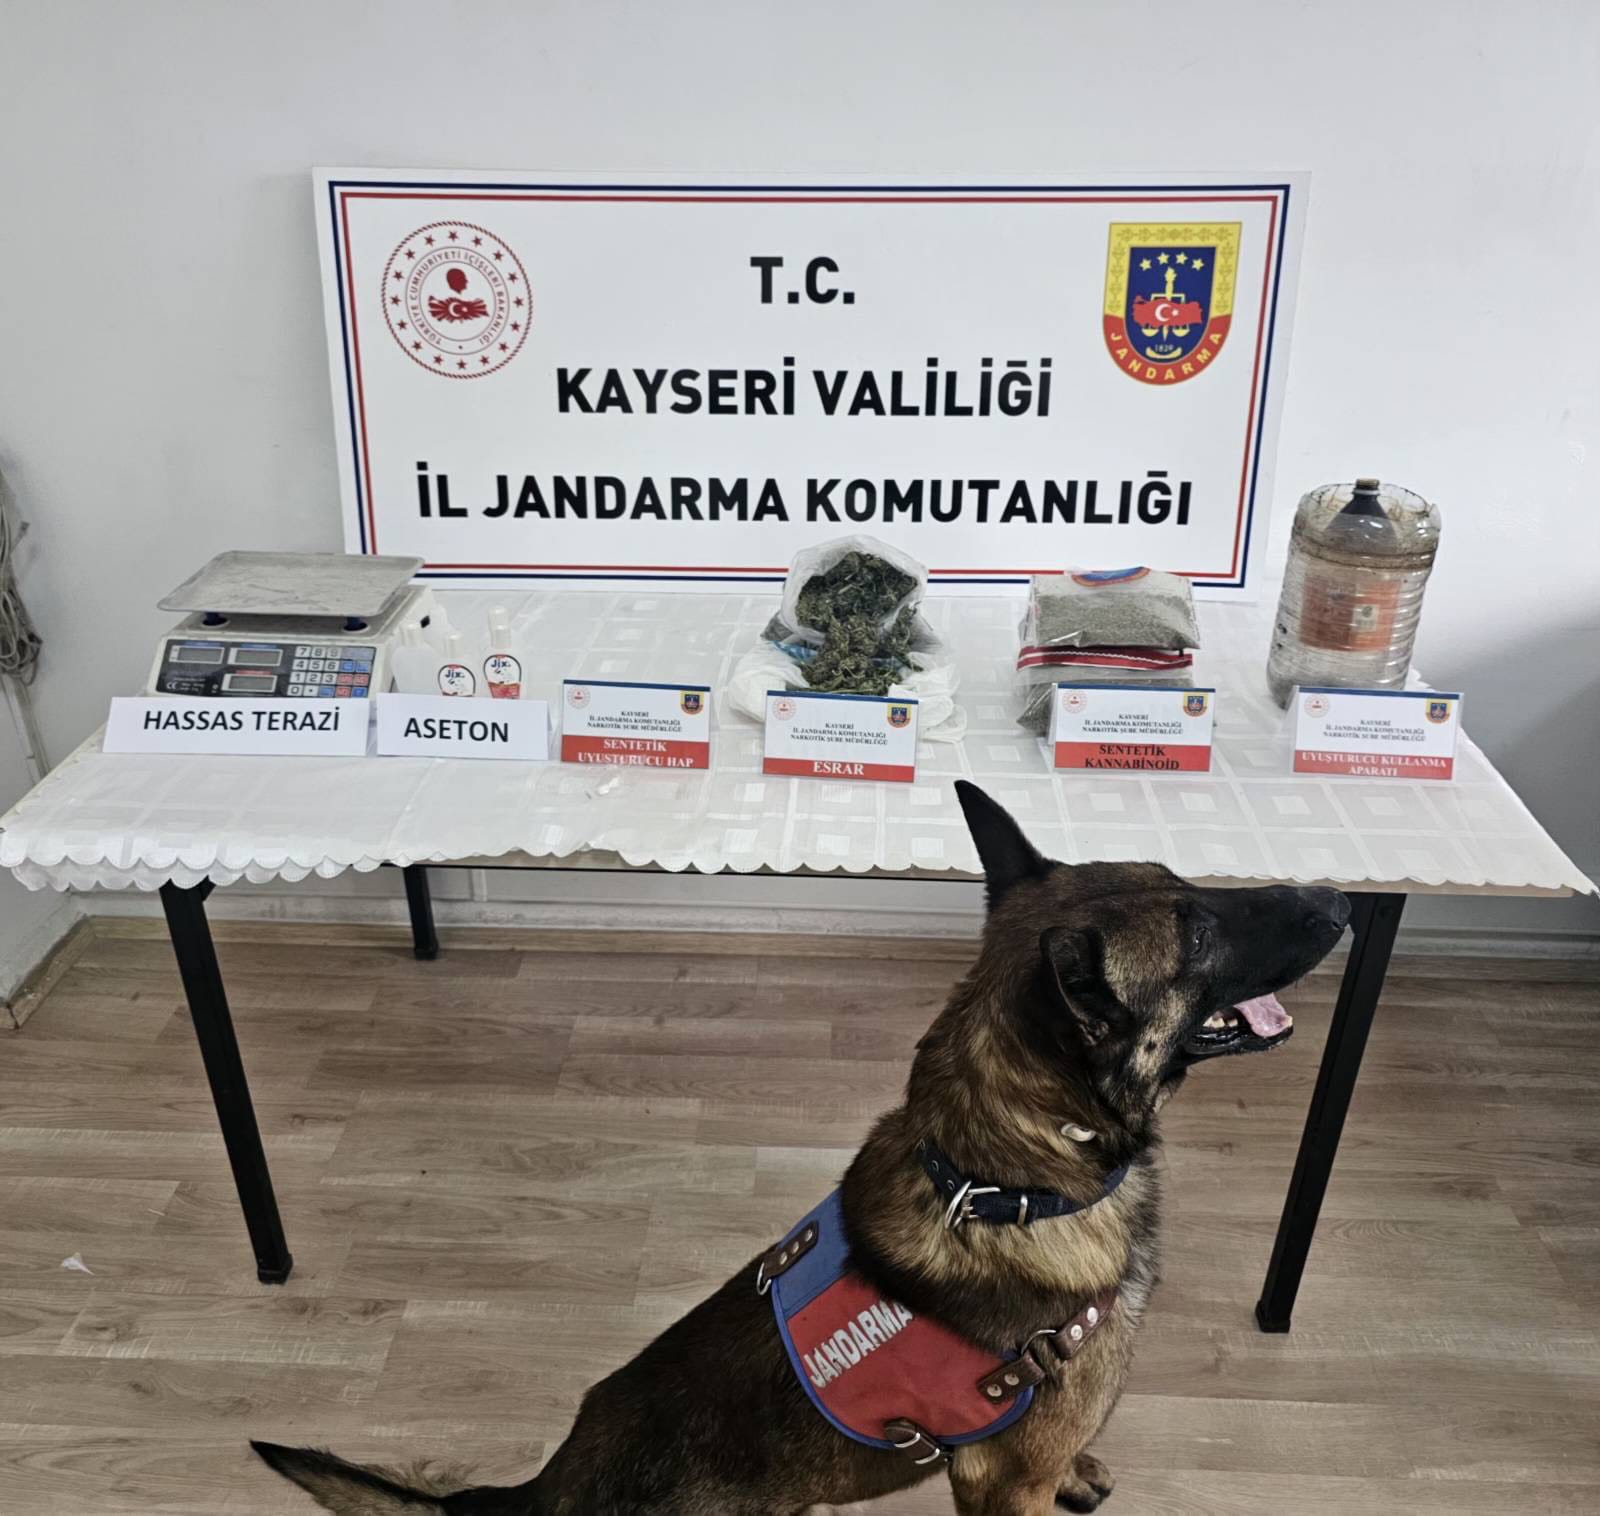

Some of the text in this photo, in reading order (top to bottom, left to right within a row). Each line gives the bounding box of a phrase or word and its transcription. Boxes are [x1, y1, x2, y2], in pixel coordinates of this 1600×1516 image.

[409, 251, 461, 300] CUMHURİYETİ
[464, 251, 502, 288] İÇİŞLERİ
[750, 256, 855, 304] T.C.
[478, 291, 504, 345] BAKANLIĞI
[1110, 332, 1222, 381] JANDARMA
[557, 357, 1052, 417] KAYSERİ VALİLİĞİ
[416, 461, 1192, 525] İL JANDARMA KOMUTANLIĞI
[143, 706, 339, 732] HASSAS TERAZİ
[403, 717, 509, 743] ASETON
[597, 716, 633, 724] JANDARMA
[801, 728, 837, 736] JANDARMA
[603, 739, 667, 752] SENTETİK
[1099, 744, 1166, 757] SENTETİK
[667, 757, 693, 768] HAP
[813, 761, 864, 775] ESRAR
[1085, 757, 1180, 770] KANNABİNOİD
[1302, 752, 1447, 768] UYUŞTURUCU KULLANMA
[1349, 765, 1398, 777] APARATI
[803, 1300, 913, 1388] JANDARMA
